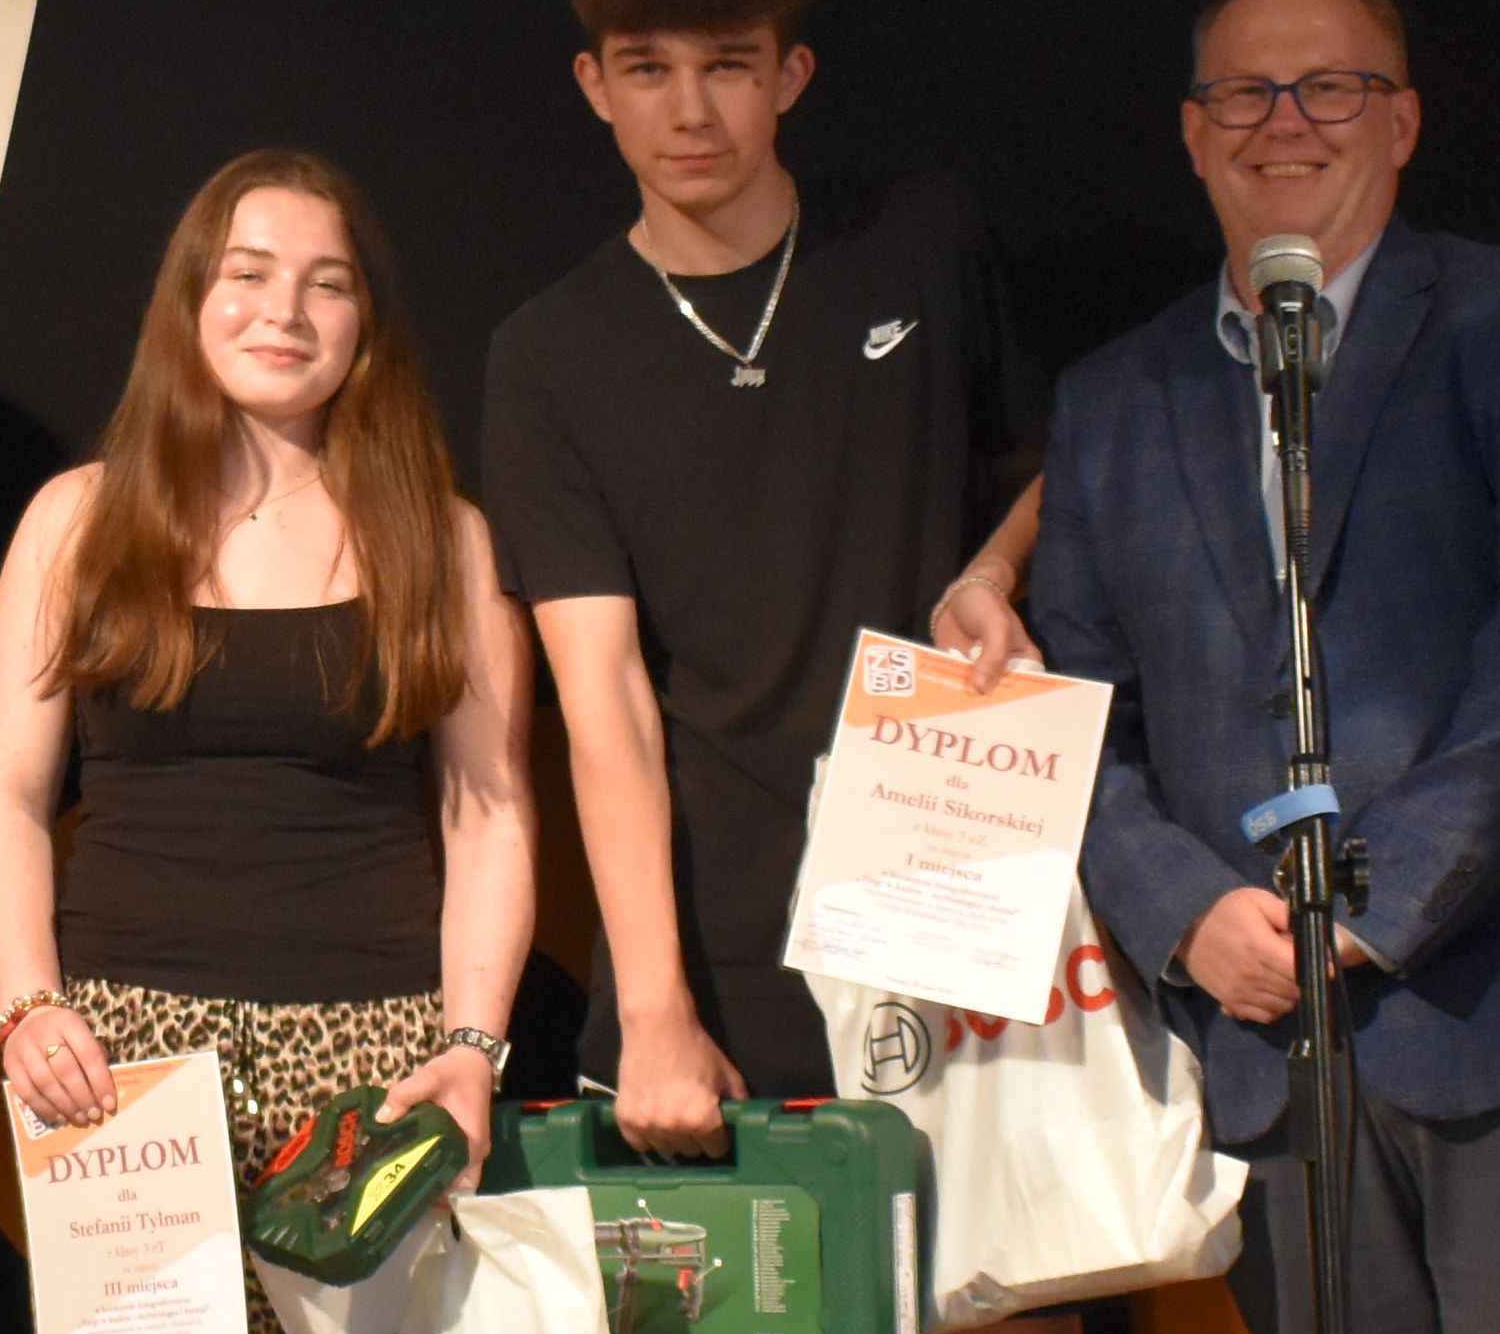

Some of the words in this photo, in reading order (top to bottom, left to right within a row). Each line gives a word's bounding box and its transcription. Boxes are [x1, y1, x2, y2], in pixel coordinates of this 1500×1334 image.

[870, 713, 1062, 781] DYPLOM
[945, 774, 970, 791] dla
[869, 782, 940, 812] Amelii
[943, 799, 1045, 838] Sikorskiej
[918, 856, 983, 883] miejsca
[45, 1135, 203, 1184] DYPLOM
[117, 1189, 138, 1203] dla
[68, 1215, 132, 1239] Stefanii
[135, 1209, 202, 1234] Tylman
[103, 1280, 123, 1297] III
[126, 1276, 179, 1295] miejsca
